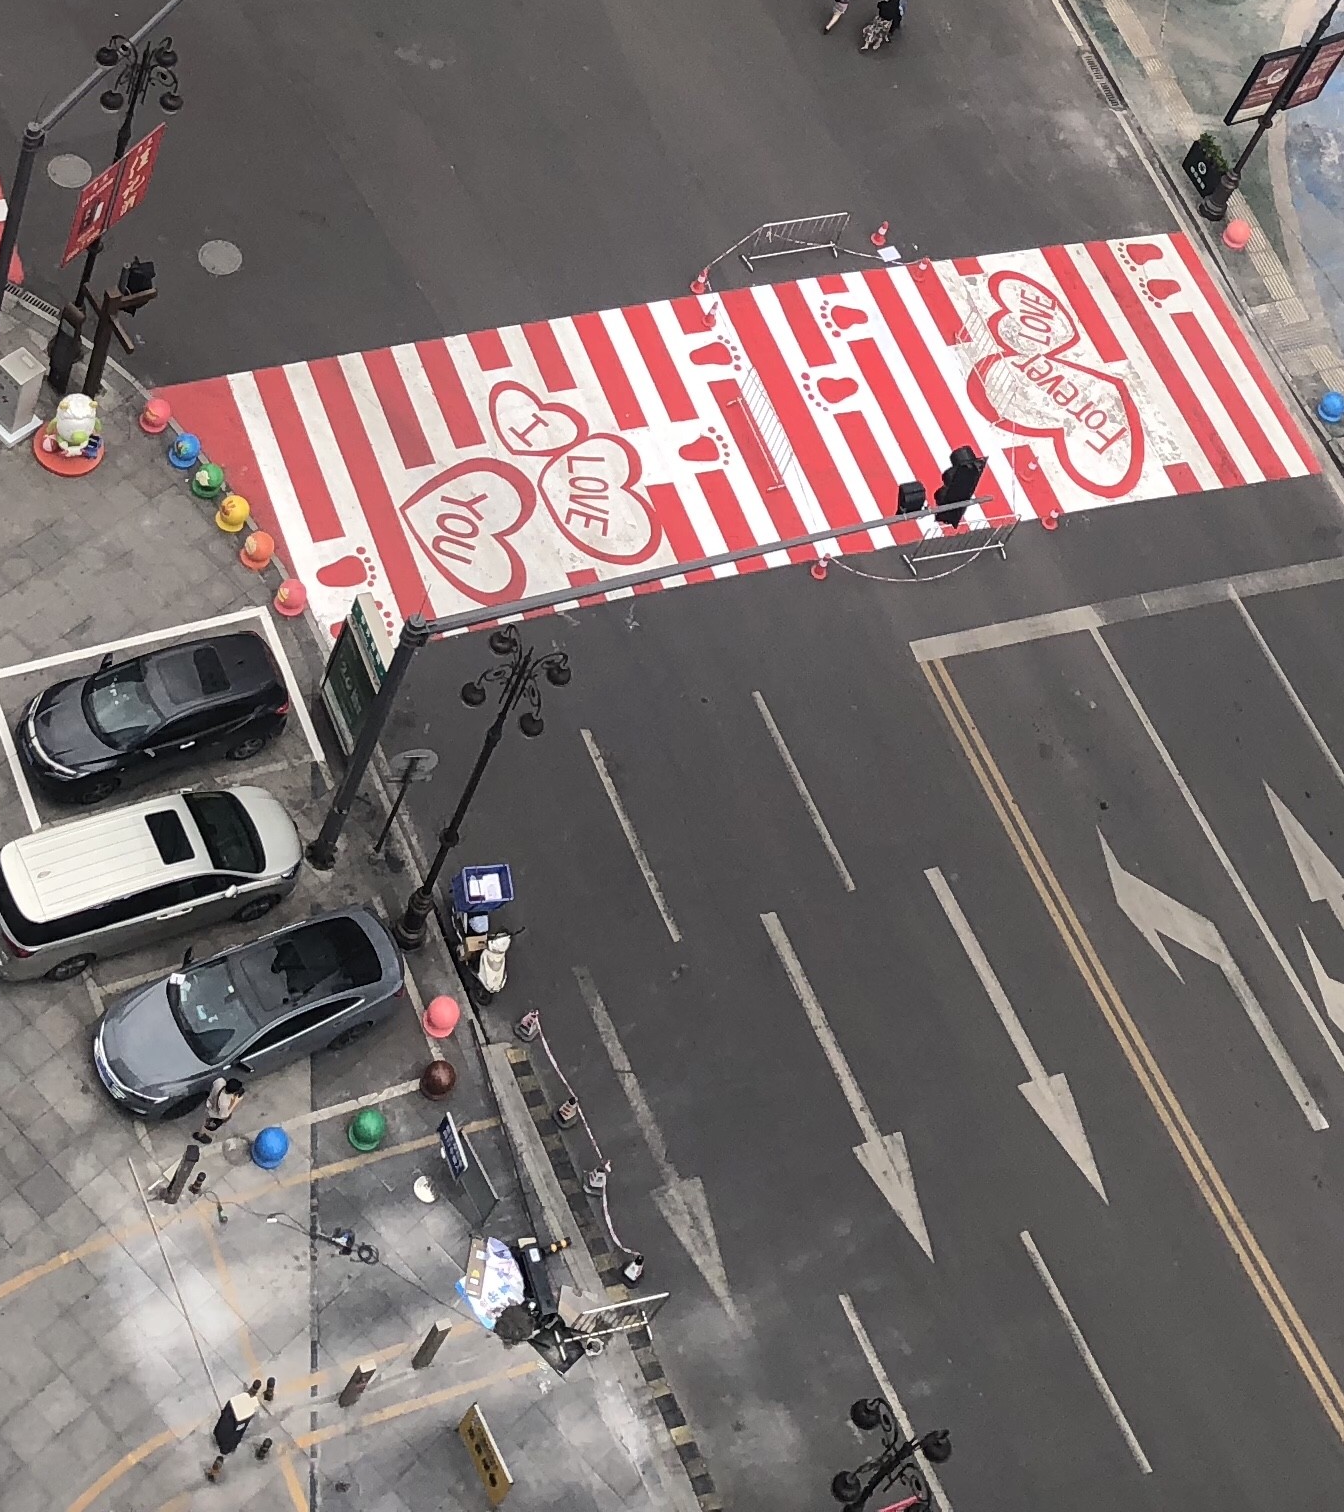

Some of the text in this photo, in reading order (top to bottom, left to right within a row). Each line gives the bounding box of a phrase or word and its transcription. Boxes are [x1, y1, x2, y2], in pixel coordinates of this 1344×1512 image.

[1018, 289, 1056, 346] LOVE
[1011, 353, 1127, 455] Forever
[431, 493, 489, 566] YOU
[565, 456, 609, 538] LOVE
